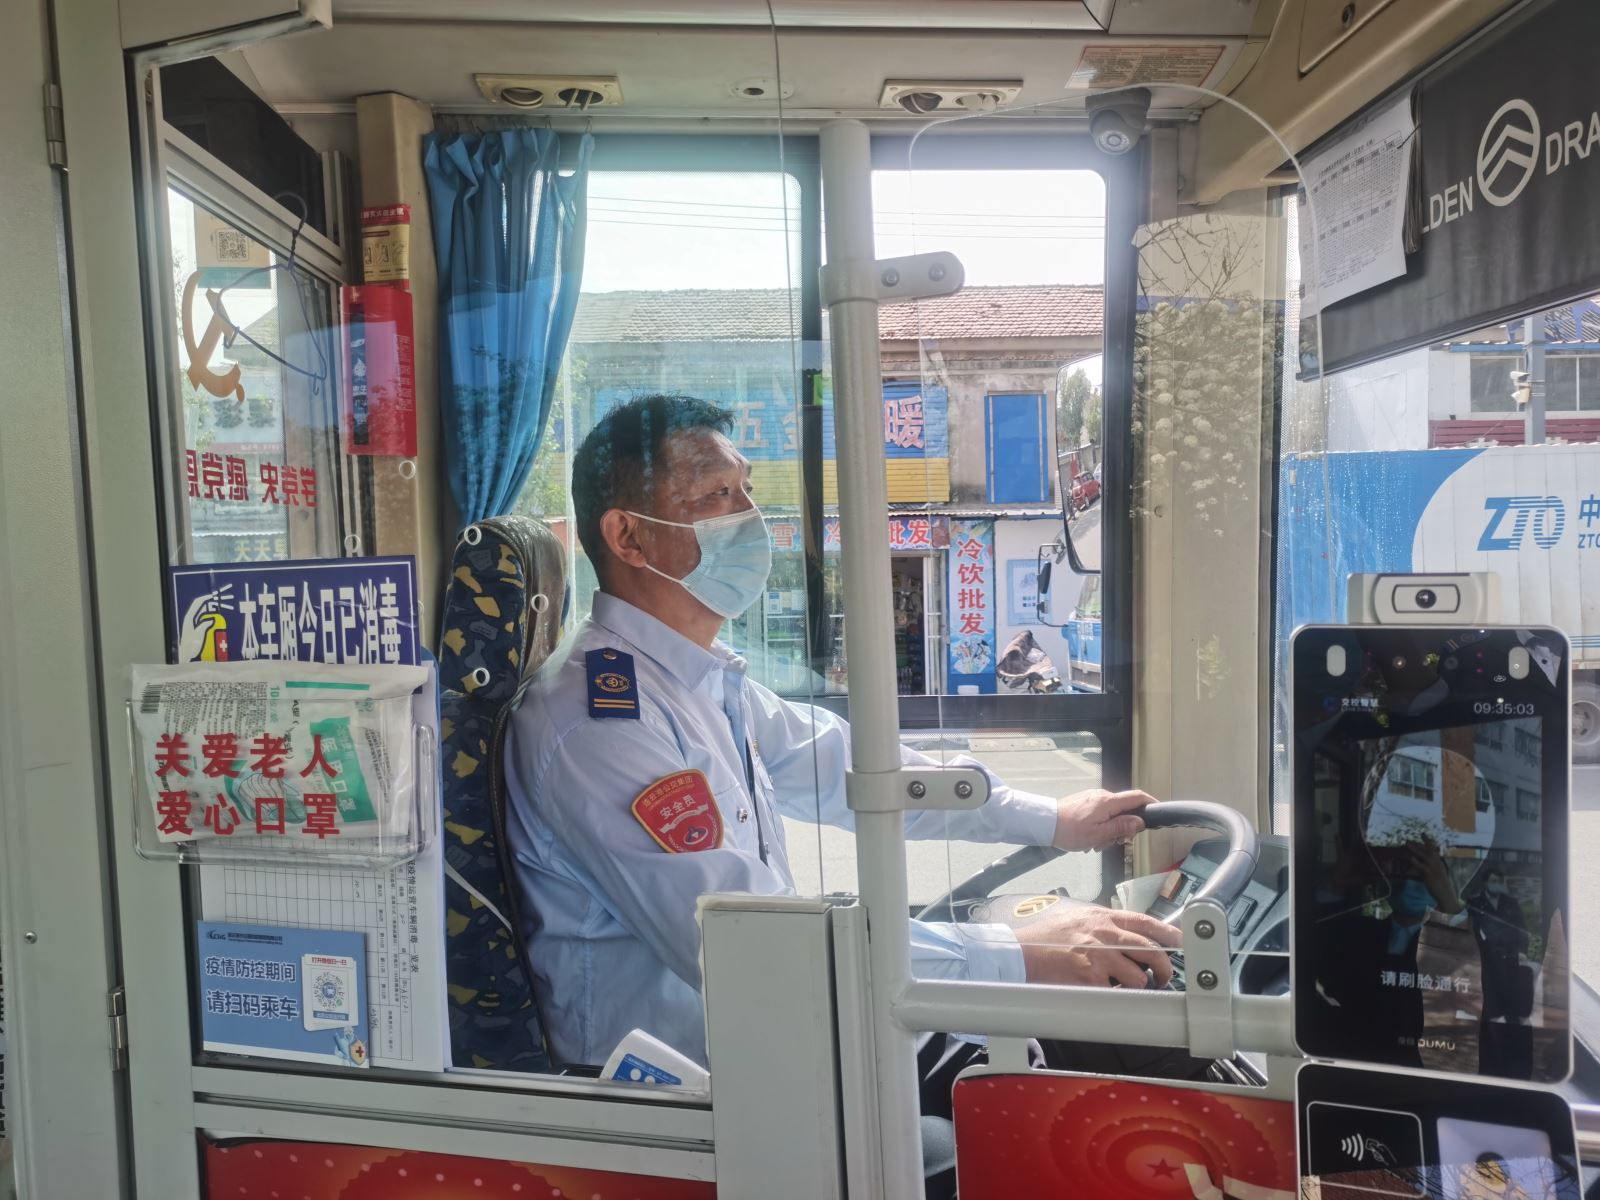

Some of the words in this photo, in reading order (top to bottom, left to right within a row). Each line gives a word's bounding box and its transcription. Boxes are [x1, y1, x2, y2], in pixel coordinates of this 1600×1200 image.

[884, 395, 925, 449] 暖
[1476, 495, 1566, 551] ZTO
[956, 537, 987, 636] 冷饮批发
[239, 577, 402, 665] 本车厢今日已消毒
[1473, 702, 1535, 716] 09:35:03
[155, 732, 338, 780] 关爱老人
[157, 789, 341, 840] 爱心口罩
[659, 794, 697, 820] 安全员
[205, 957, 296, 982] 疫情防控期间
[1381, 970, 1472, 994] 请刷脸通行
[206, 990, 299, 1020] 请扫码乘车
